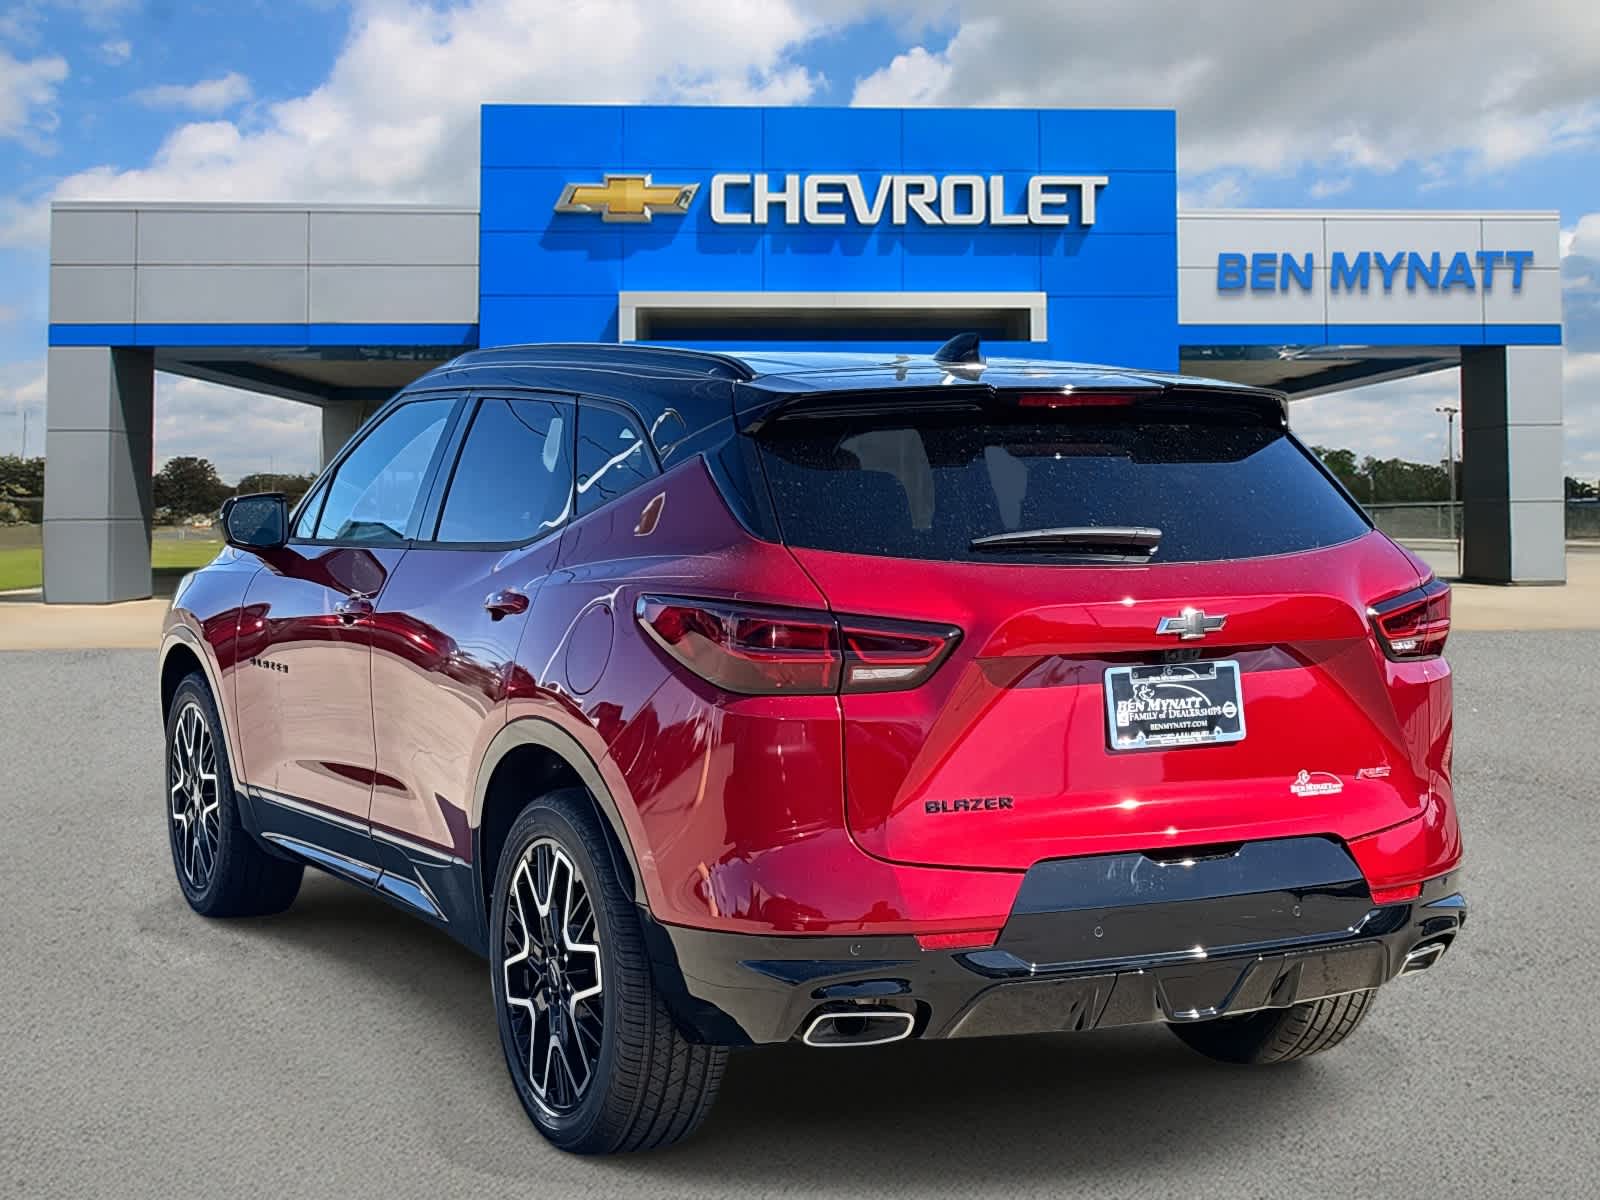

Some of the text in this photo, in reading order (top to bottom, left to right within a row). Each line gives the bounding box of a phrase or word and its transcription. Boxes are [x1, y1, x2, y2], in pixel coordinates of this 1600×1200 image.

[711, 173, 1110, 226] CHEVROLET
[1217, 250, 1535, 290] BEN MYNATT
[1147, 696, 1203, 712] MYNATT
[1129, 711, 1158, 721] FAMILY
[925, 796, 1014, 814] BLAZER
